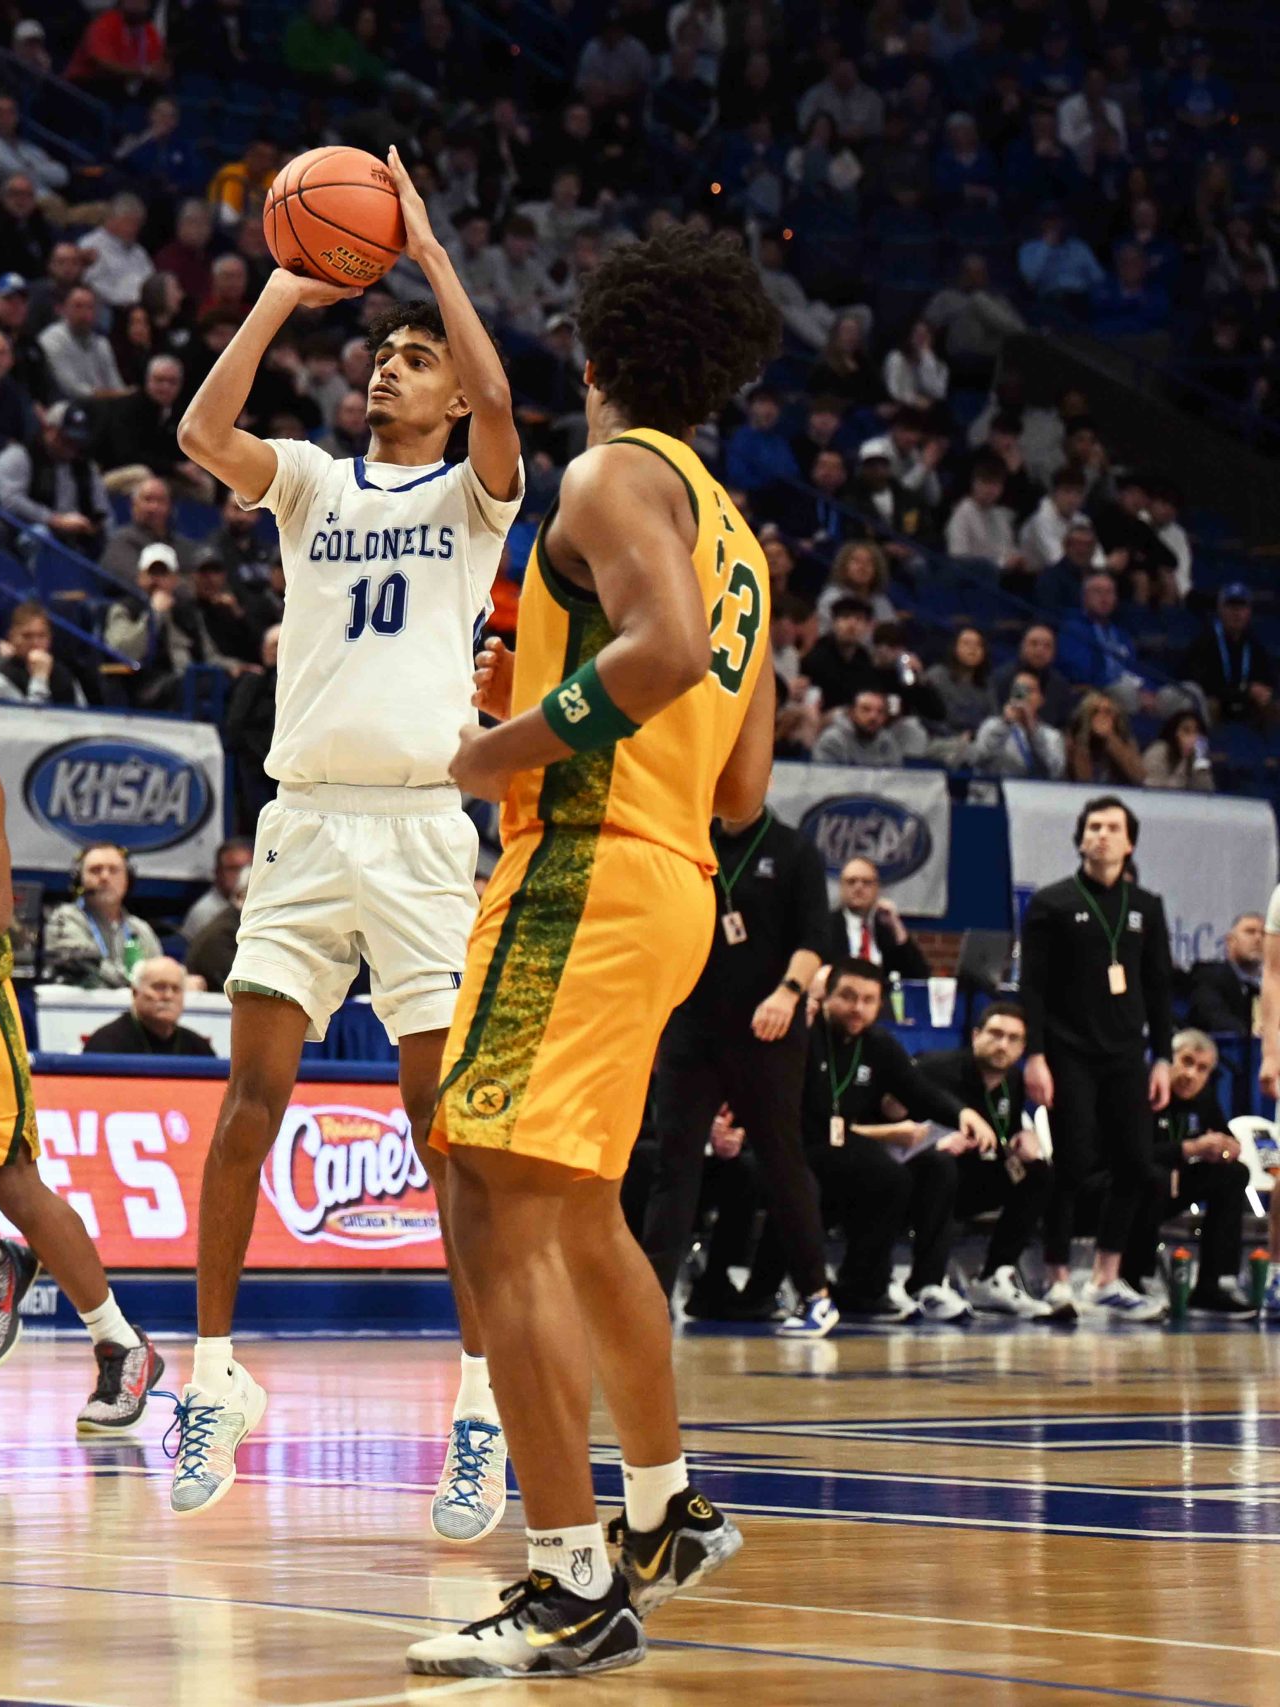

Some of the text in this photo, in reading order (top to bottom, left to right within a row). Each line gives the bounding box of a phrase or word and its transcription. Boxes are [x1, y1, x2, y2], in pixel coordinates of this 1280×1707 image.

[310, 524, 455, 563] COLONELS
[345, 570, 409, 642] 10
[558, 682, 590, 724] 23
[49, 757, 191, 826] KHSAA
